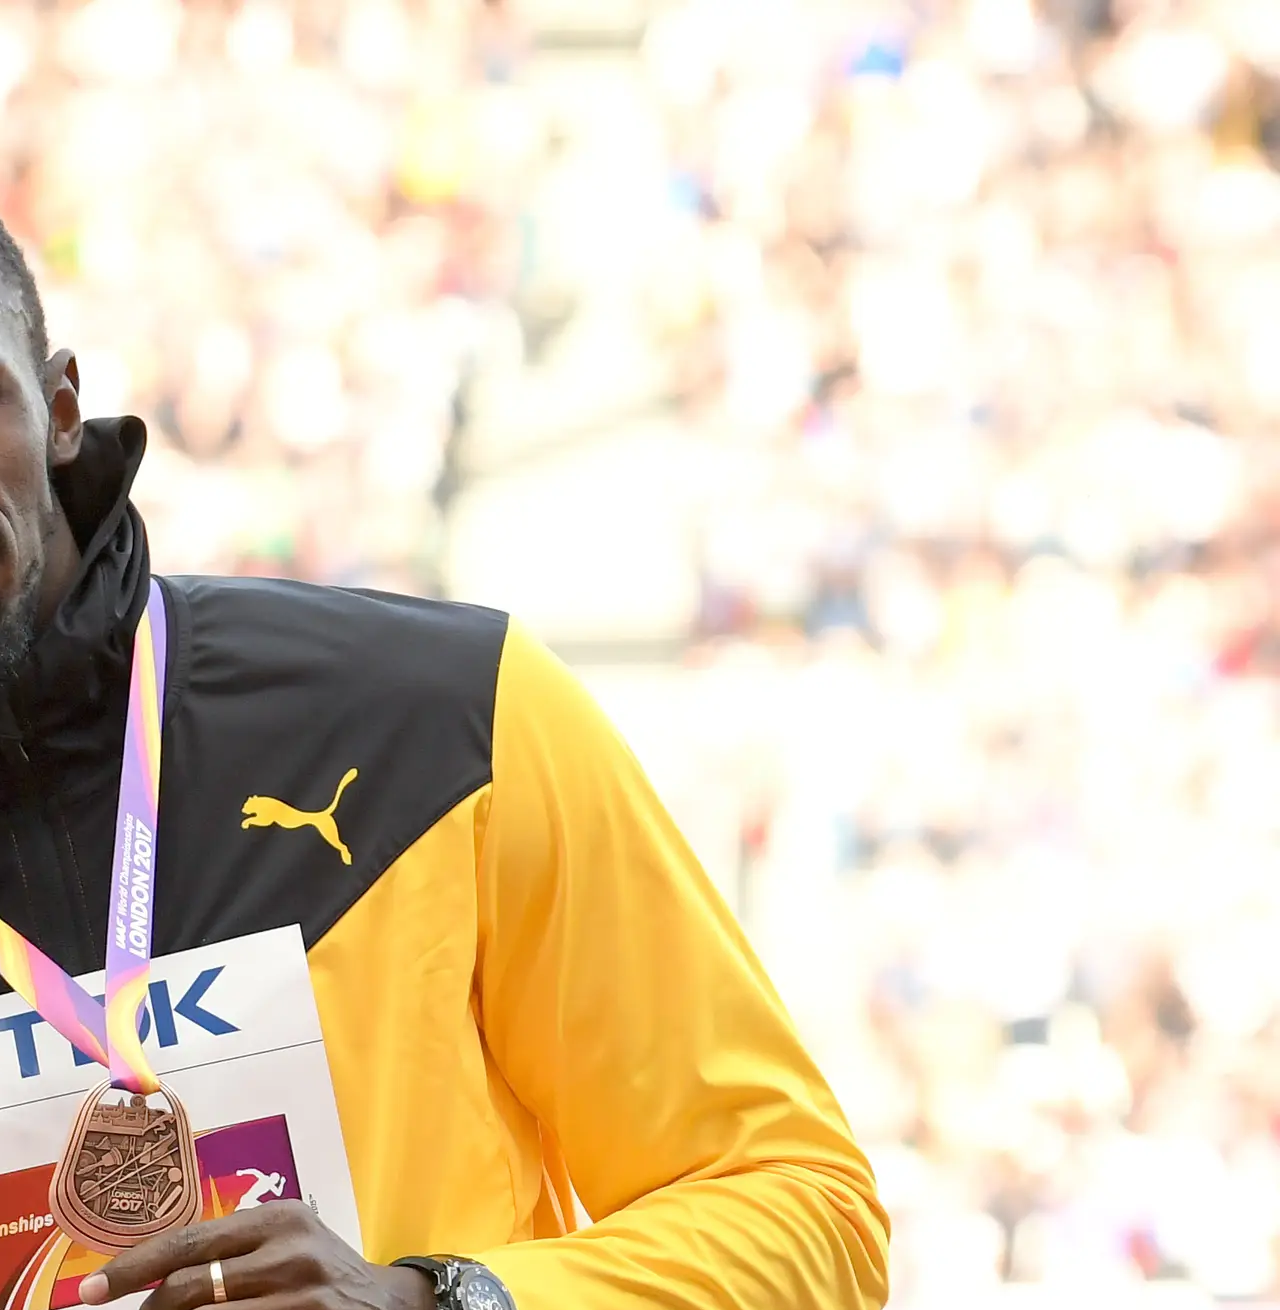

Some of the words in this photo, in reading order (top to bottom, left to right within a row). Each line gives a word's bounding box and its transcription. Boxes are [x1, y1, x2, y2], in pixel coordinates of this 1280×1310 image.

[120, 812, 134, 885] Championships
[133, 818, 153, 870] 2017
[118, 885, 128, 916] World
[129, 868, 151, 959] LONDON
[116, 916, 126, 949] IAAF
[110, 1199, 143, 1212] 2017
